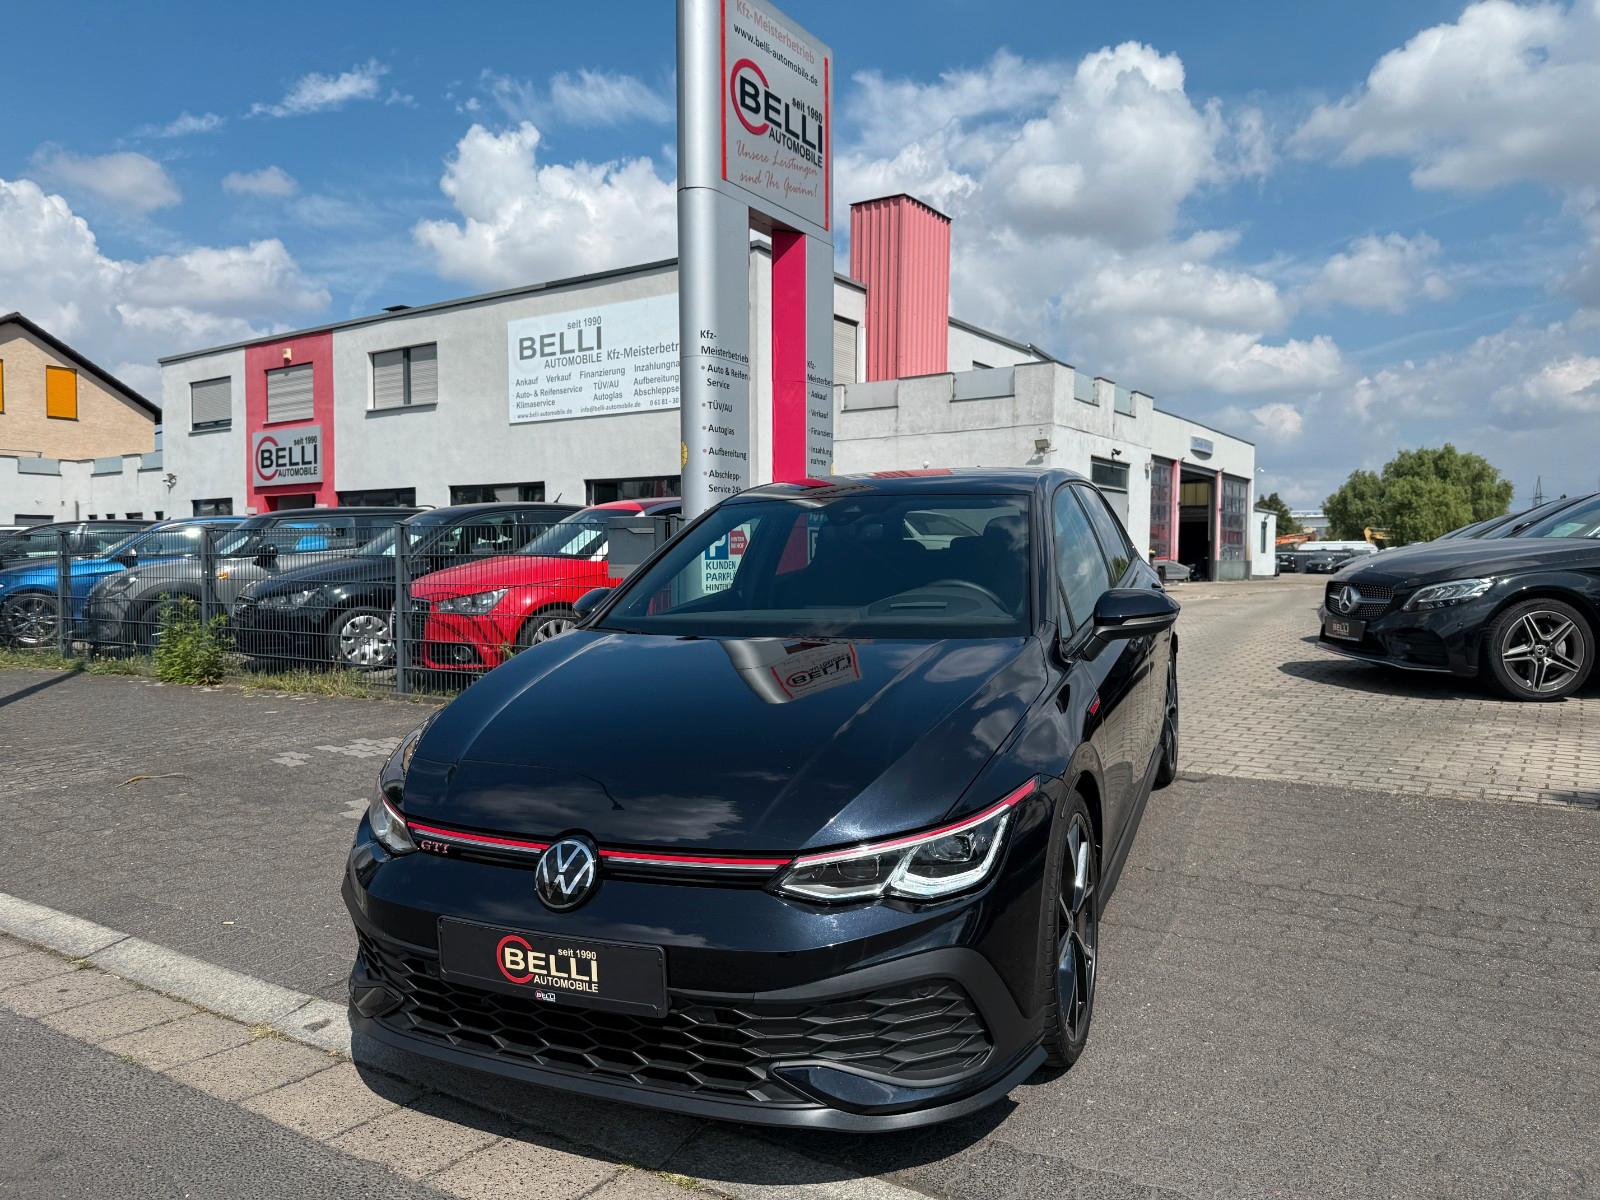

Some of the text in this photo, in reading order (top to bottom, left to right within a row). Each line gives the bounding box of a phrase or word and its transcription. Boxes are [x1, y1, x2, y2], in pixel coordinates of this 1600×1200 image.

[737, 0, 815, 64] Kfz-Meisterbetrieb
[734, 24, 818, 86] www.belli-automobile.de
[740, 75, 822, 154] BELLI
[792, 97, 822, 124] seit 1990
[769, 127, 822, 168] AUTOMOBILE
[737, 140, 818, 179] Unsere Leistungen
[740, 169, 818, 198] sind Ihr Gewinn!
[567, 316, 602, 330] seit 1990
[700, 330, 717, 339] Kfz-
[519, 326, 602, 360] BELLI
[544, 352, 603, 369] AUTOMOBILE
[701, 345, 749, 363] Meisterbetrieb
[515, 376, 539, 387] Ankauf
[546, 372, 572, 383] Verkauf
[579, 367, 626, 380] Finanzierung
[707, 364, 724, 375] Auto
[725, 368, 730, 376] &
[593, 374, 680, 390] TÜV/AU Aufbereitung
[707, 378, 731, 389] Service
[515, 391, 533, 399] Auto-
[540, 385, 583, 397] Reifenservice
[593, 391, 623, 401] Autoglas
[810, 390, 828, 401] Ankauf
[516, 399, 556, 409] Klimaservice
[707, 400, 733, 412] TÜV/AU
[811, 409, 829, 419] Verkauf
[708, 424, 735, 436] Autoglas
[294, 435, 318, 446] seit 1990
[260, 444, 318, 469] BELLI
[708, 447, 747, 460] Aufbereitung
[278, 466, 318, 478] AUTOMOBILE
[709, 469, 742, 482] Abschlepp-
[708, 484, 732, 494] Service
[705, 560, 736, 570] KUNDEN
[420, 839, 450, 854] GTI
[557, 947, 597, 961] seit 1990
[504, 947, 598, 983] BELLI
[533, 974, 599, 993] AUTOMOBILE
